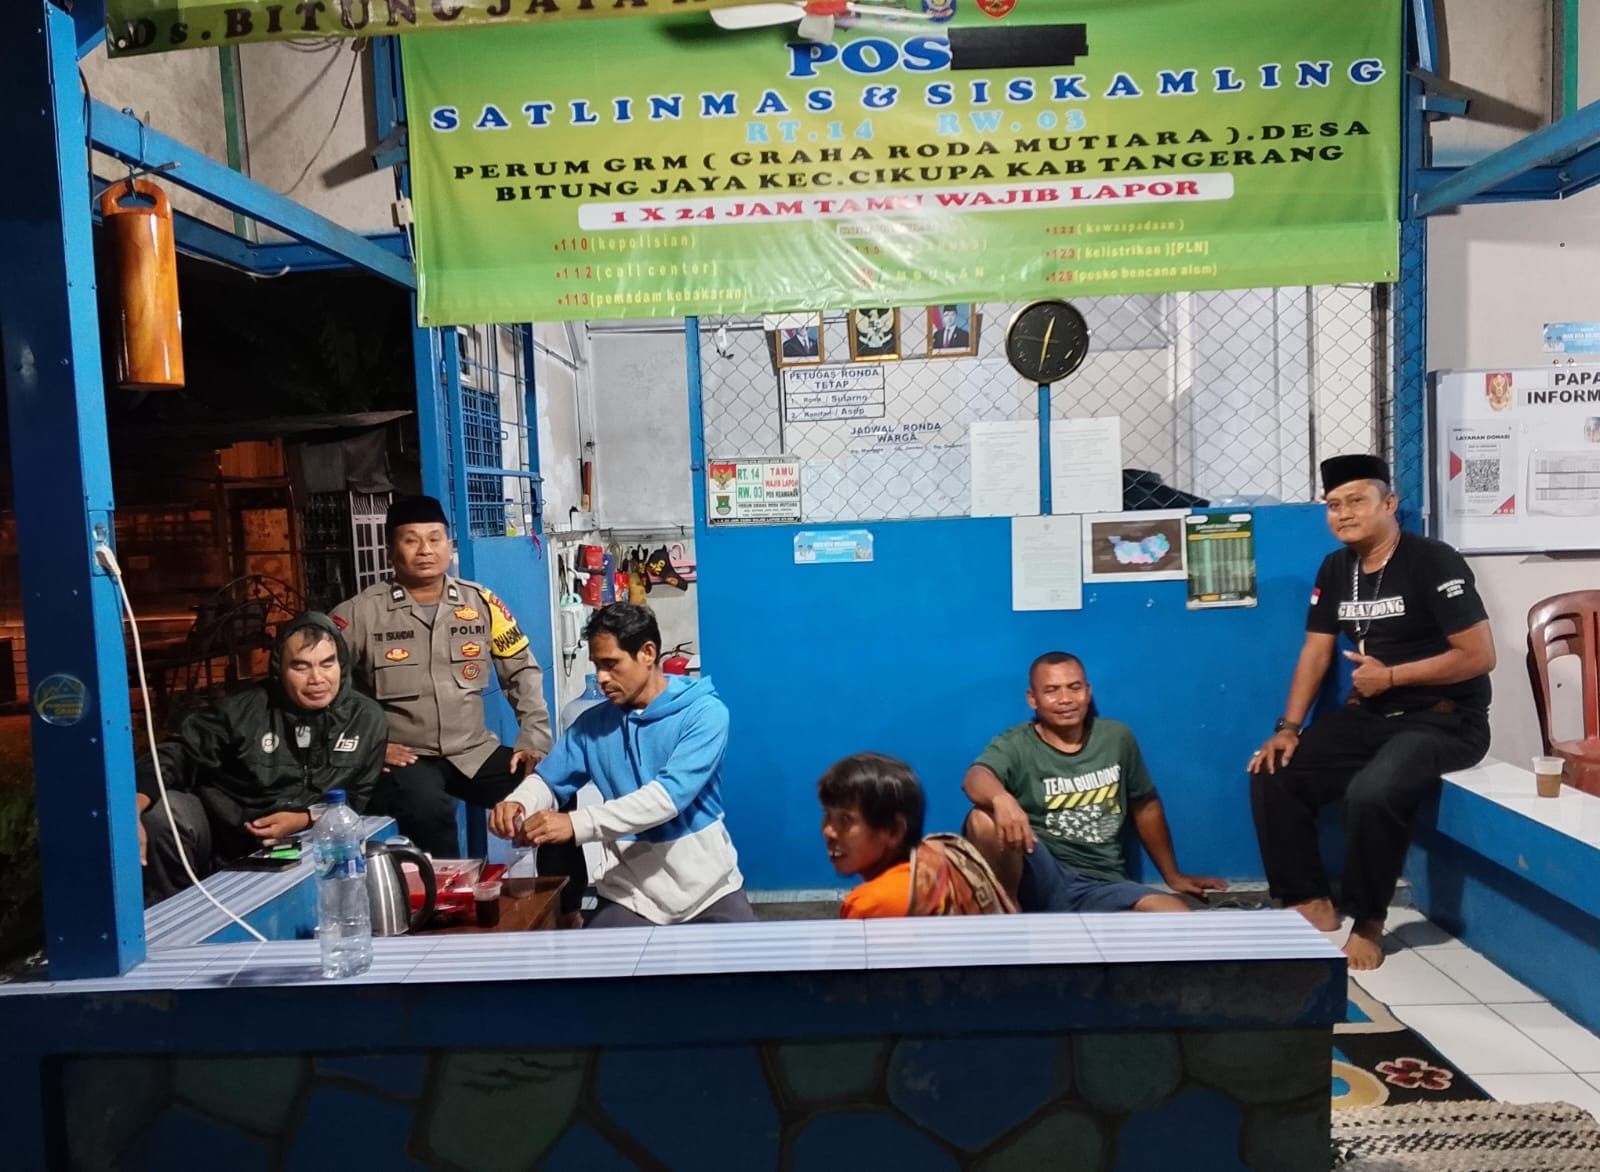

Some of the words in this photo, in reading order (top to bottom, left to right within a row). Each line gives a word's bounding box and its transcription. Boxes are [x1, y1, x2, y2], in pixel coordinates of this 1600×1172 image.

[787, 36, 951, 77] POS
[432, 89, 834, 130] SATLINMAS
[862, 86, 898, 108] &
[927, 60, 1384, 105] SISKAMLING
[453, 160, 590, 180] PERUM
[603, 154, 689, 173] GRM
[730, 146, 874, 166] GRAHA
[887, 141, 1001, 160] RODA
[1014, 128, 1213, 153] MUTIARA
[496, 181, 640, 202] BITUNG
[650, 175, 747, 194] JAYA
[1006, 158, 1088, 178] KAB
[1098, 146, 1345, 173] TANGERANG
[611, 211, 628, 223] 1
[639, 208, 666, 222] X
[675, 206, 716, 220] 24
[725, 200, 804, 217] JAM
[814, 194, 923, 214] TAMU
[935, 186, 1060, 207] WAJIB
[1070, 180, 1200, 200] LAPOR
[790, 371, 836, 380] PETUGAS
[841, 368, 880, 378] RONDA
[815, 380, 849, 390] TETAP
[1527, 389, 1600, 405] INFORM
[850, 425, 895, 435] JADWAL
[903, 422, 942, 432] RONDA
[877, 433, 918, 442] WARGA
[770, 466, 794, 477] TAMU
[450, 625, 486, 637] POLRI
[1043, 777, 1077, 795] TEAM
[1073, 764, 1121, 793] BUILDING
